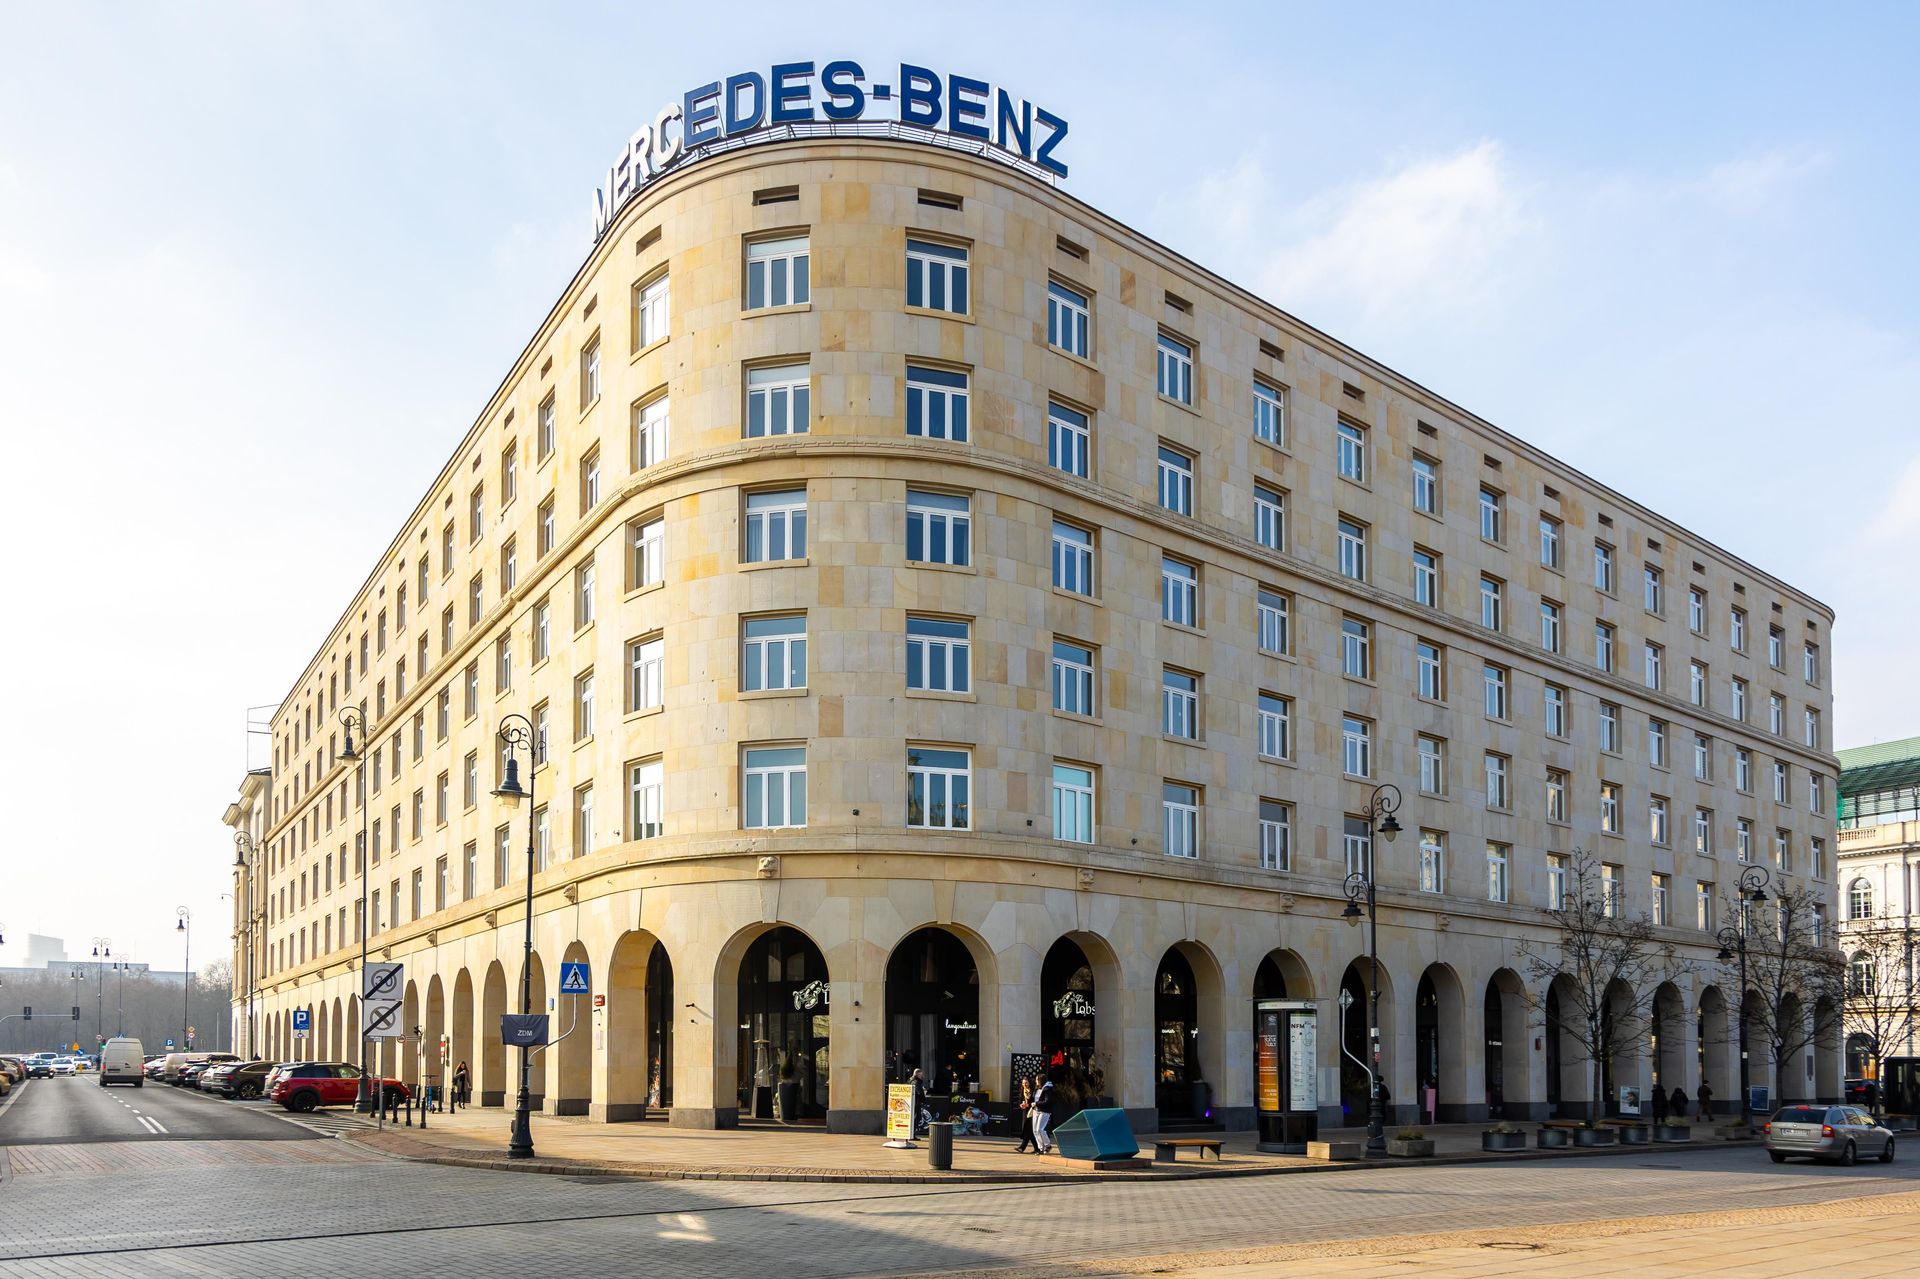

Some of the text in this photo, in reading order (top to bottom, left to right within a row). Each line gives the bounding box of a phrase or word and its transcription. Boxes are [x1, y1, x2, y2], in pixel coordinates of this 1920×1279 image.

[592, 60, 1069, 243] MERCEDES-BENZ
[296, 1012, 307, 1025] P
[517, 1029, 533, 1037] ZDM
